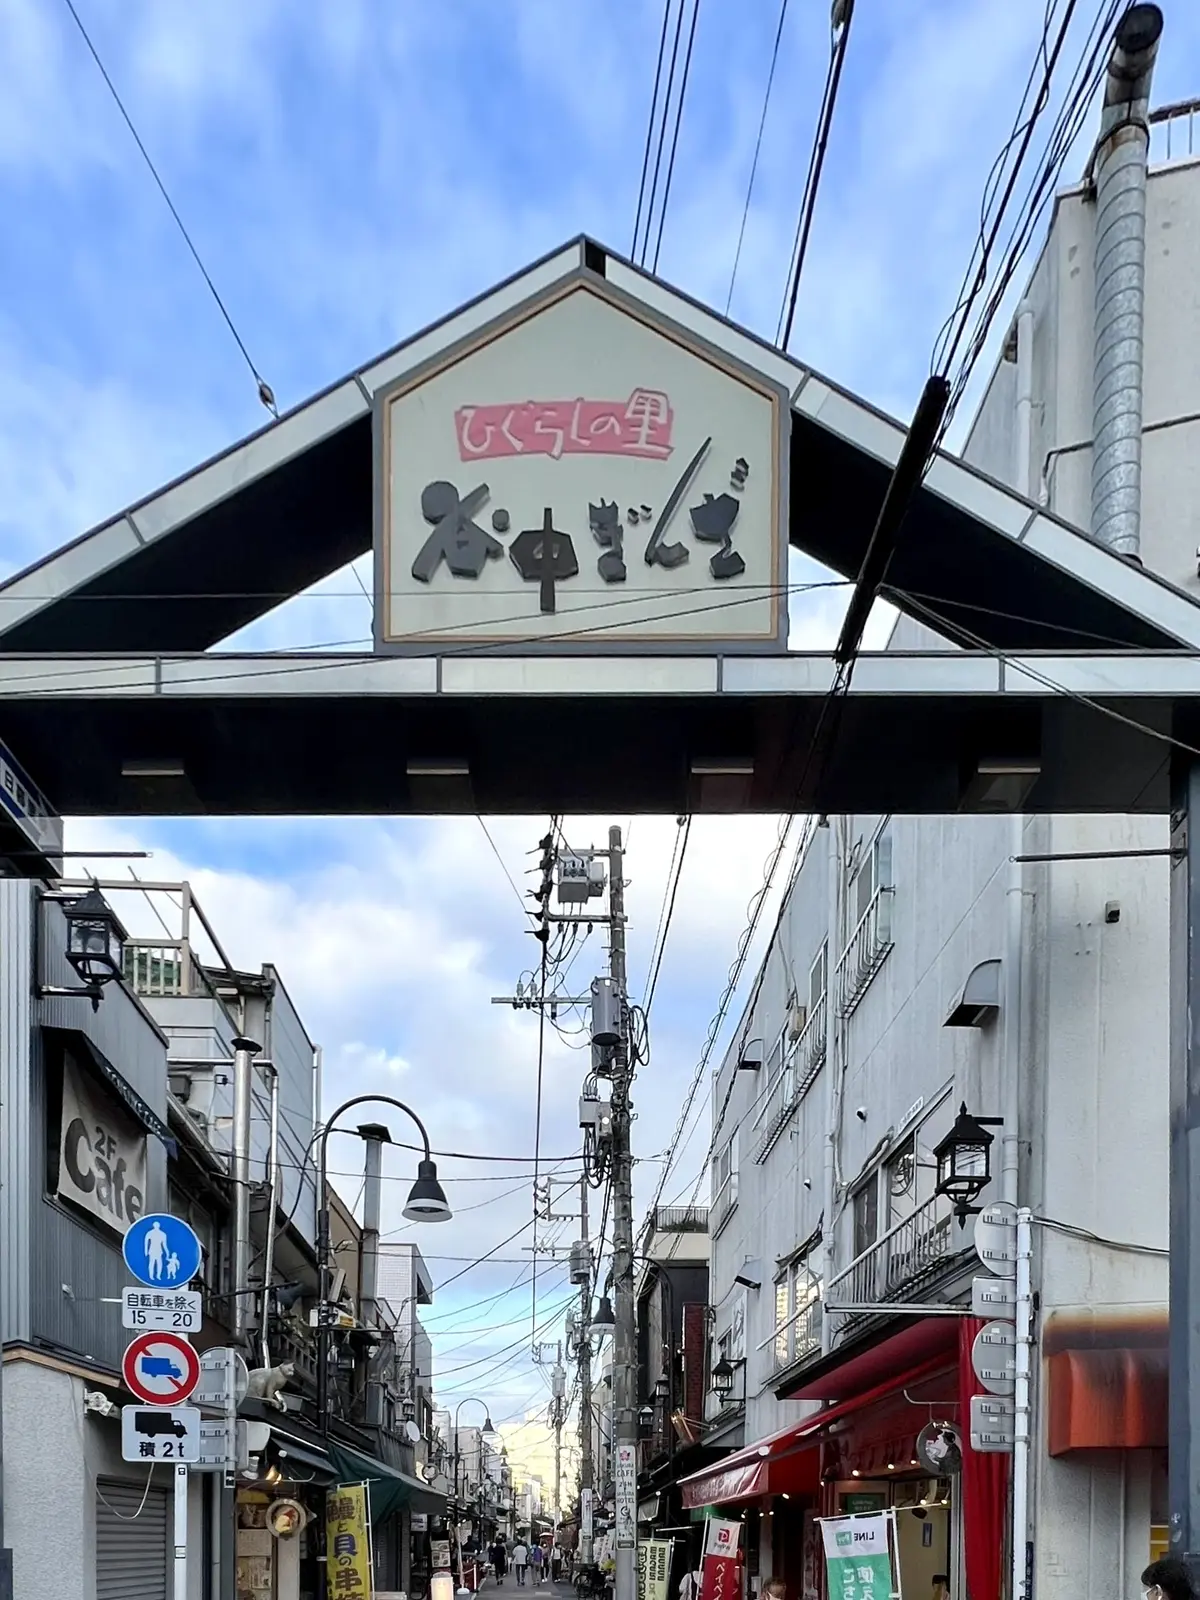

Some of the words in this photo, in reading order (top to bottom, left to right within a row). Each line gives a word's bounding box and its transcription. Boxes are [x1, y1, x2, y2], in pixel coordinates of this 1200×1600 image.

[460, 388, 675, 460] ひぐらしの里
[412, 436, 750, 616] 谷中ぎんざ
[95, 1126, 117, 1161] 2F
[64, 1117, 144, 1225] Cafe
[127, 1292, 197, 1311] 自転車を除く
[131, 1310, 146, 1325] 15
[172, 1313, 193, 1327] 20
[139, 1441, 156, 1458] 積
[616, 1469, 634, 1478] CAFE
